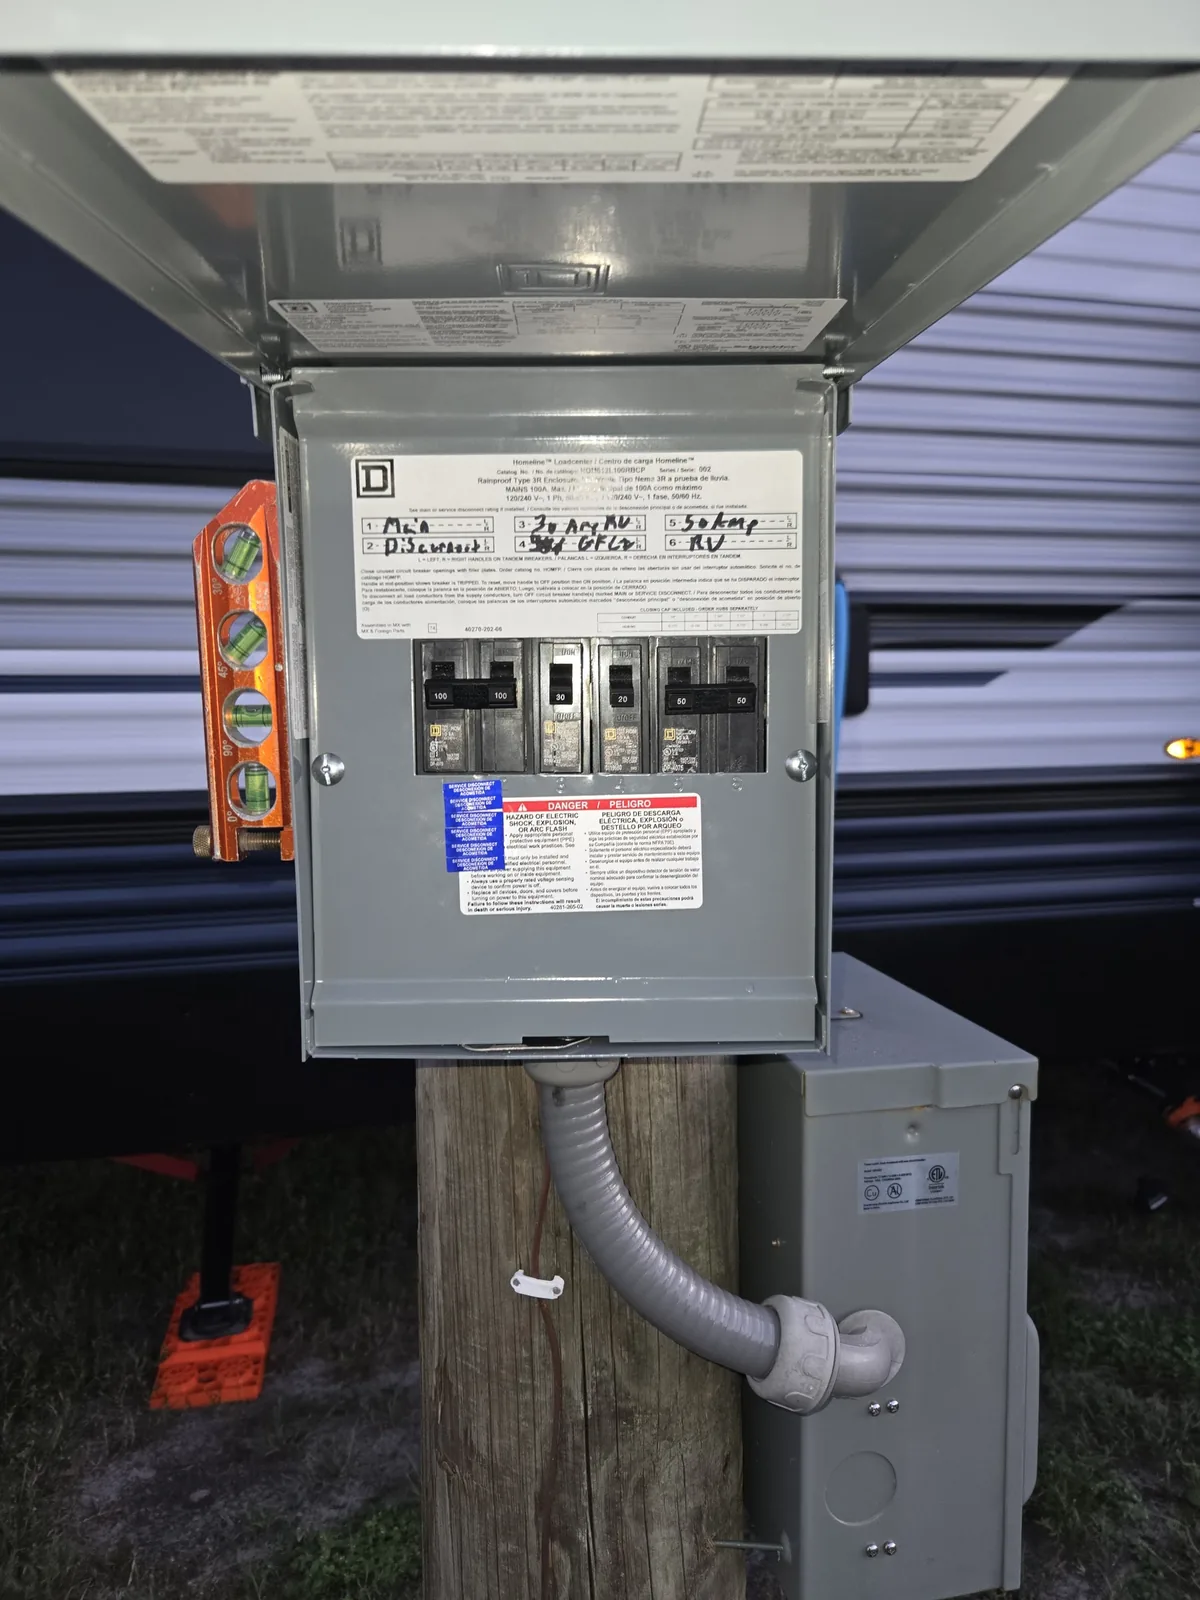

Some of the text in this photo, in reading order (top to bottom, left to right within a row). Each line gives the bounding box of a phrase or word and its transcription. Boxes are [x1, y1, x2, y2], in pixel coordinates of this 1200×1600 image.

[690, 534, 725, 552] RV
[217, 661, 228, 678] 45°
[223, 740, 233, 756] 90°
[548, 801, 588, 810] DANGER
[609, 800, 651, 808] PELIGRO
[227, 811, 237, 822] 0°
[866, 1189, 877, 1197] Cu
[889, 1186, 900, 1196] Al
